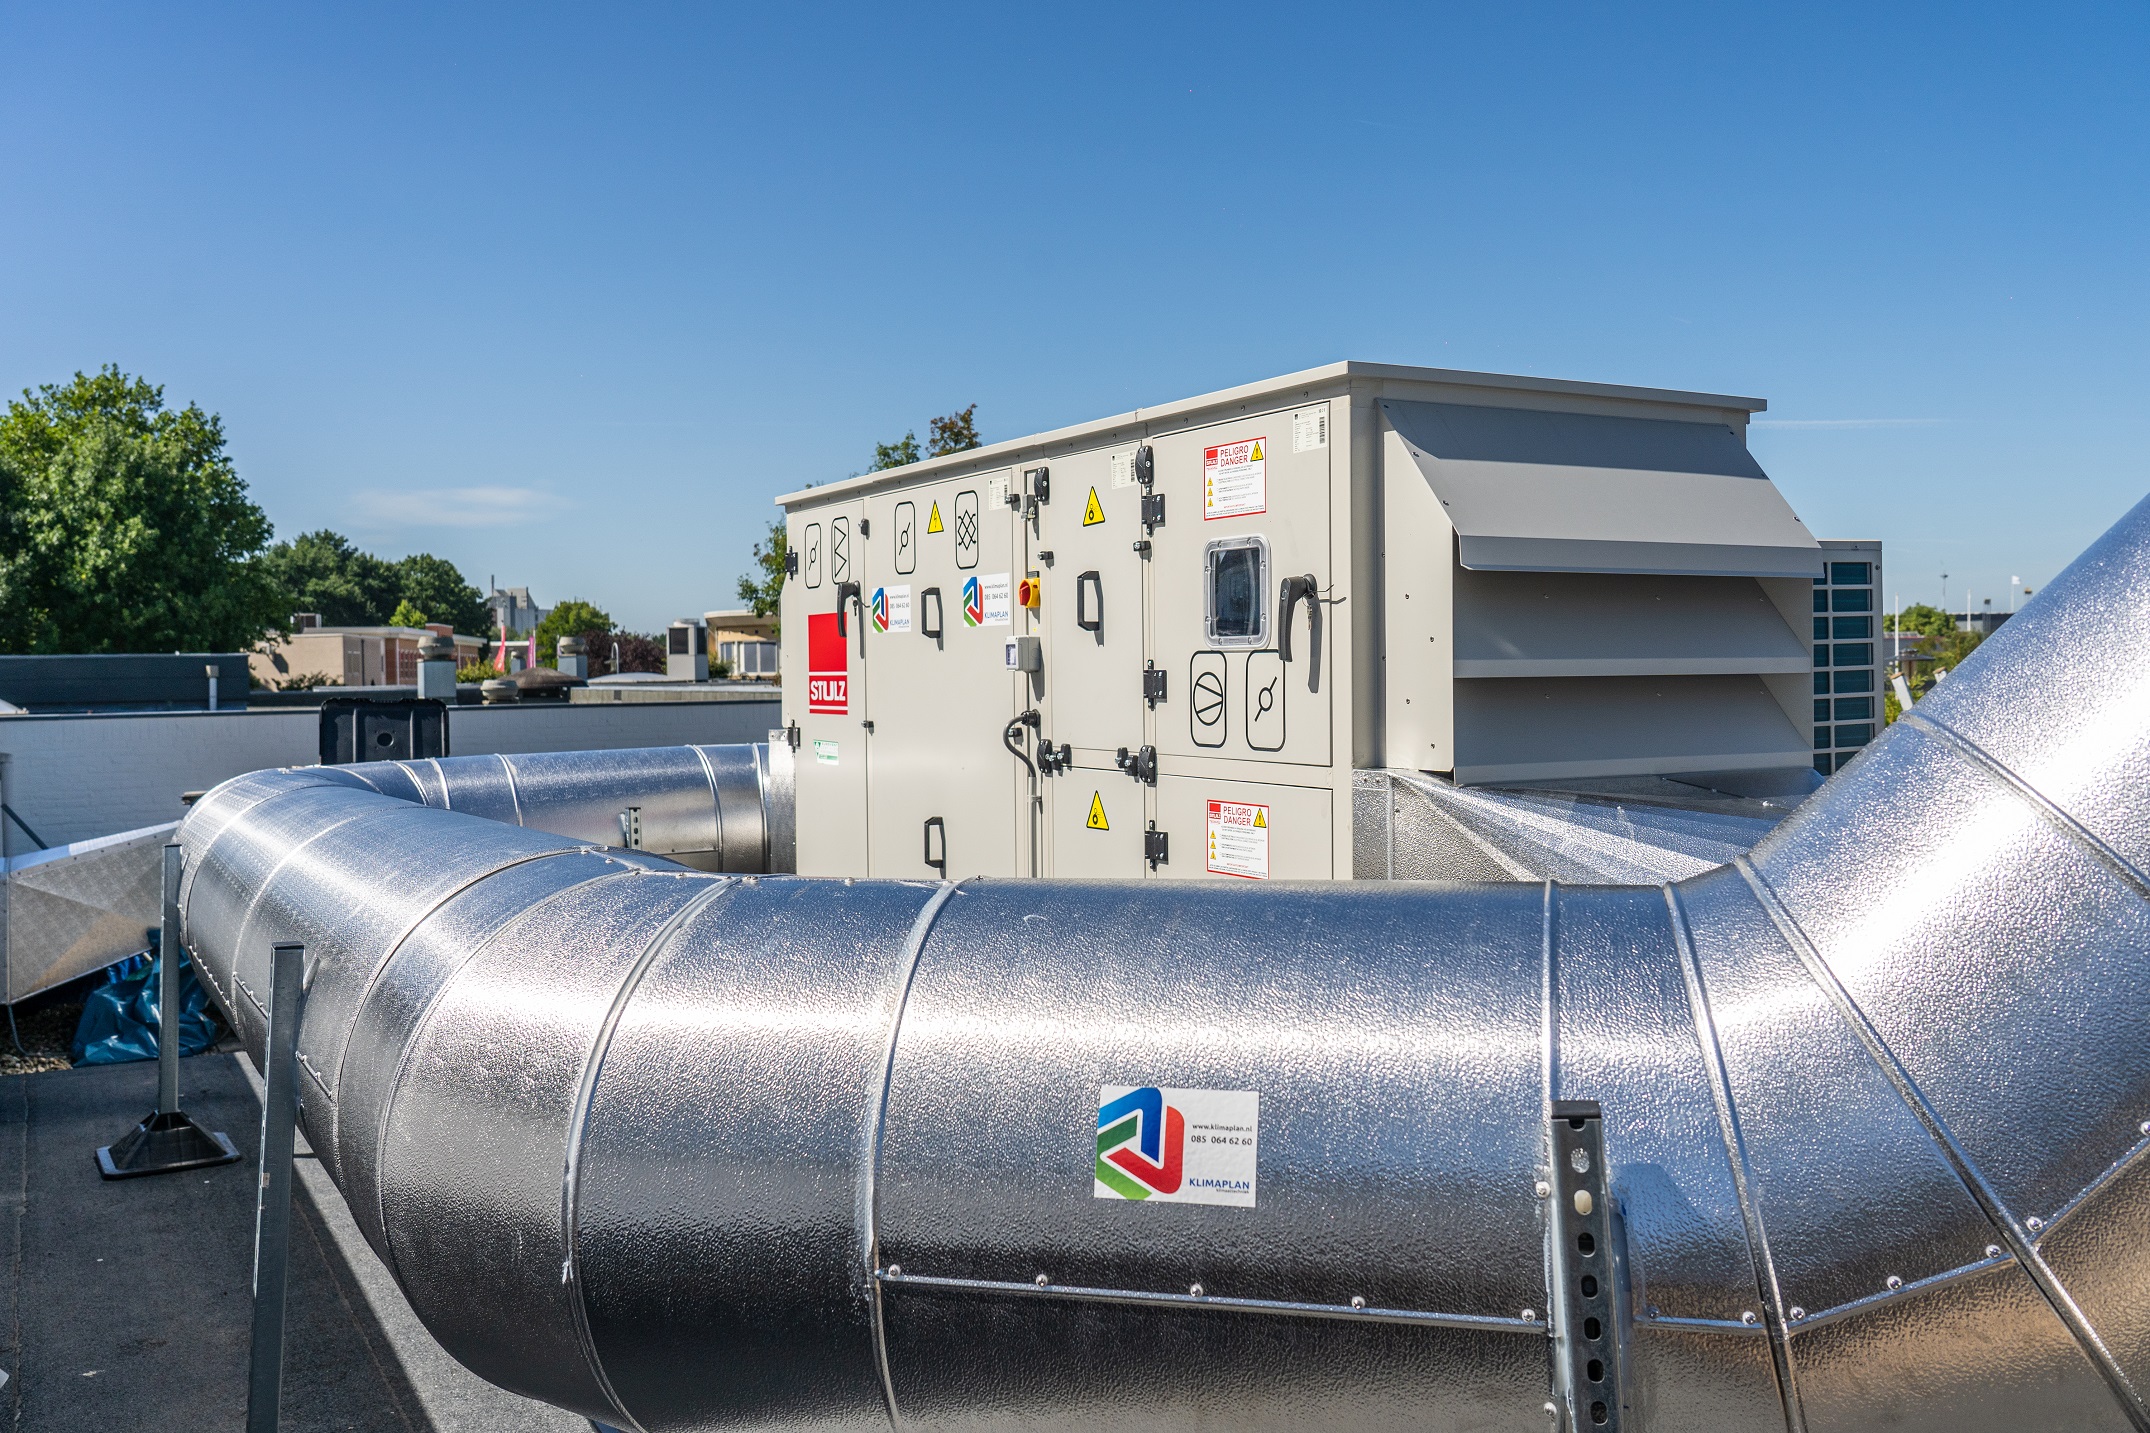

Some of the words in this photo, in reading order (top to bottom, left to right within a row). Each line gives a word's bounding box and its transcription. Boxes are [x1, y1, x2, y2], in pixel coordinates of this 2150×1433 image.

[1220, 445, 1249, 458] PELIGRO
[1220, 455, 1248, 467] DANGER
[984, 610, 1009, 619] KLIMAPLAN
[810, 680, 846, 702] STULZ
[1223, 806, 1252, 817] PELIGRO
[1223, 815, 1252, 826] DANGER
[1192, 1123, 1252, 1132] www.klimaplan.nl
[1191, 1135, 1206, 1143] 085
[1211, 1136, 1226, 1144] 064
[1229, 1137, 1239, 1145] 62
[1242, 1138, 1252, 1146] 60
[1189, 1178, 1250, 1189] KLIMAPLAN
